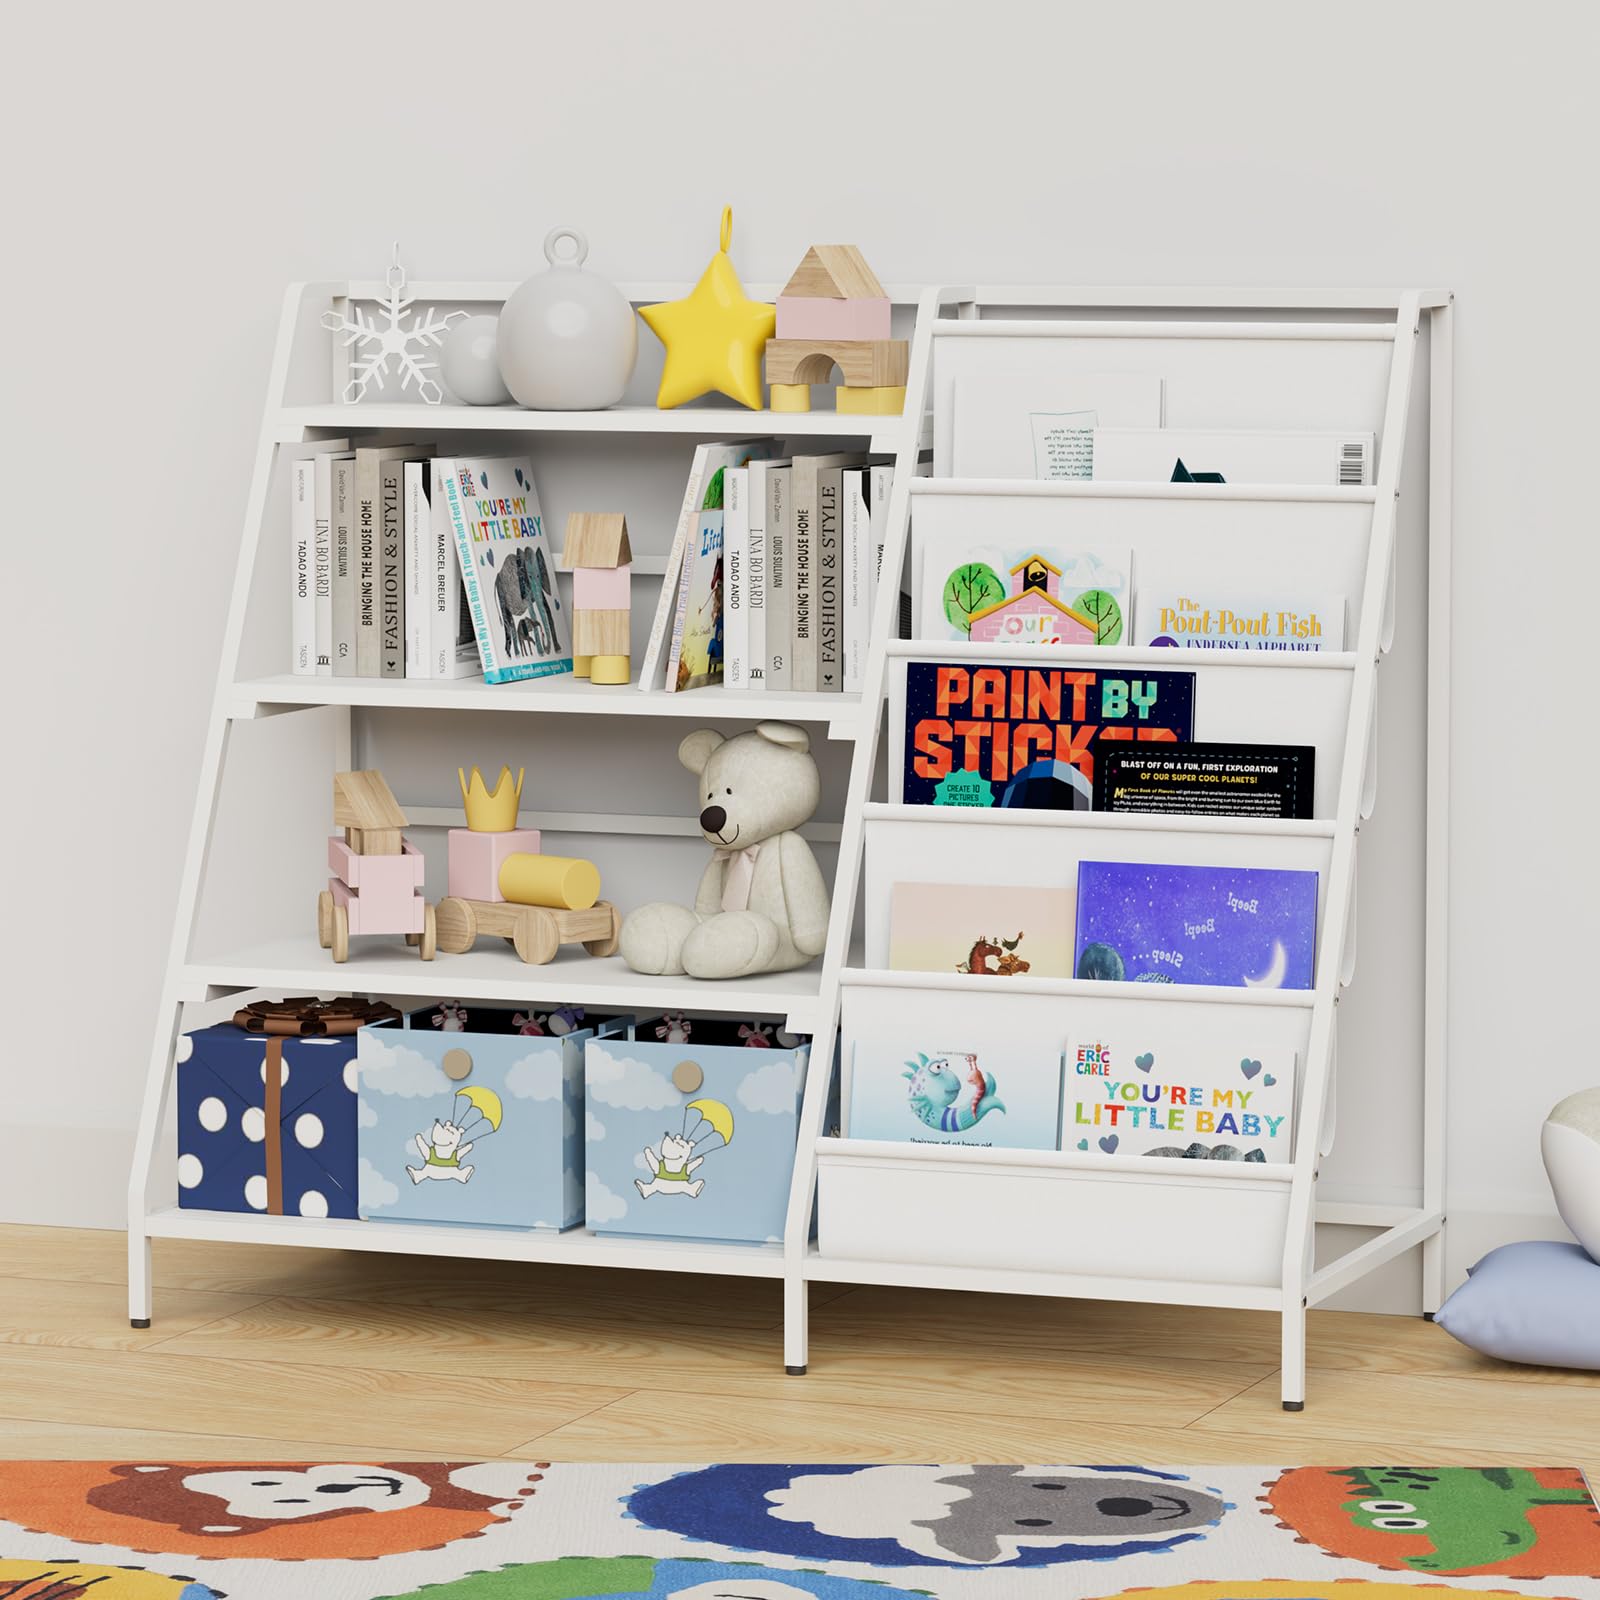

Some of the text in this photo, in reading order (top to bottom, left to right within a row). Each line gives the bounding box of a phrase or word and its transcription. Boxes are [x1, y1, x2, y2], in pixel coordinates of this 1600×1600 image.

[445, 478, 458, 500] Book
[475, 497, 526, 517] YOU'RE MY
[450, 502, 473, 569] Touch-and-Feel
[471, 516, 542, 542] LITTLE BABY
[316, 519, 329, 597] LINA BO BARDI
[338, 526, 347, 577] LOUIS SULLIVAN
[361, 500, 373, 626] BRINGING THE HOUSE HOME
[384, 478, 398, 650] FASHION & STYLE
[773, 536, 782, 588] LOUIS SULLIVAN
[298, 540, 307, 598] TADAO ANDO
[731, 550, 739, 609] TADAO ANDO
[750, 529, 763, 609] LINA BO BARDI
[798, 509, 809, 638] BRINGING THE HOUSE HOME
[822, 486, 836, 663] FASHION & STYLE
[473, 604, 484, 626] Little
[676, 589, 688, 614] Truck
[1177, 598, 1200, 612] The
[478, 627, 489, 640] My
[672, 617, 684, 637] Blue
[1159, 608, 1322, 639] Pout-Pout Fish
[339, 643, 347, 657] CCA
[482, 641, 494, 670] You're
[670, 640, 681, 663] Little
[773, 656, 782, 671] CCA
[936, 667, 1157, 721] PAINT BY
[914, 719, 1178, 785] STICK
[1120, 760, 1145, 768] BLAST
[1226, 764, 1278, 773] EXPLORATION
[1172, 773, 1196, 781] SUPER
[972, 784, 980, 792] 10
[1076, 1062, 1109, 1076] CARLE
[1103, 1081, 1254, 1109] YOU'RE MY
[1075, 1102, 1285, 1138] LITTLE BABY
